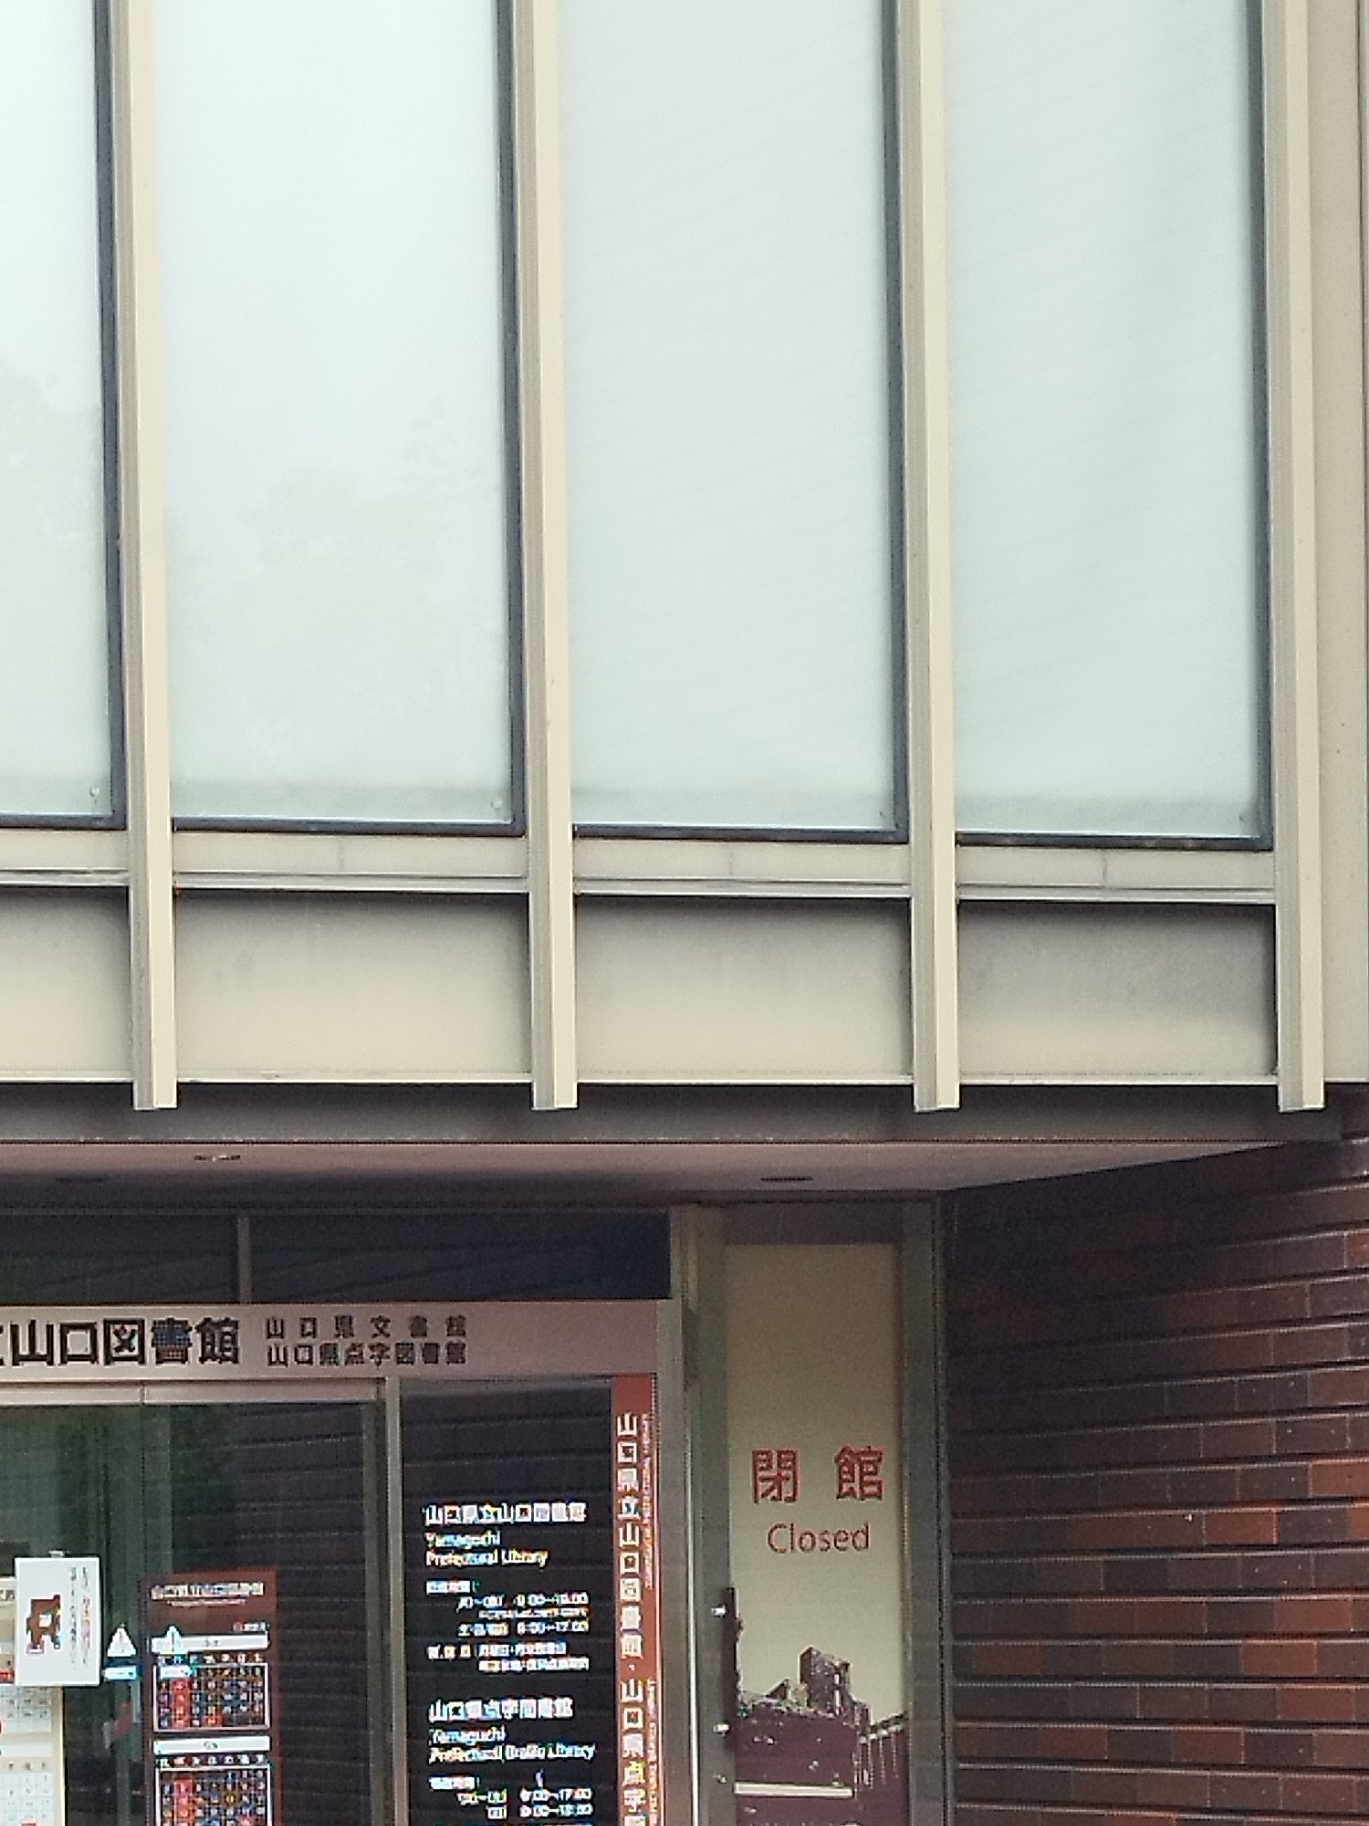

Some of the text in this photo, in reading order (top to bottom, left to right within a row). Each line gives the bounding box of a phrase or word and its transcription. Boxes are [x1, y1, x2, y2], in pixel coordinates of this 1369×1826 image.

[266, 1314, 467, 1339] 山口県文書館
[267, 1342, 467, 1368] 山口県点字図書館
[767, 1521, 870, 1554] Closed
